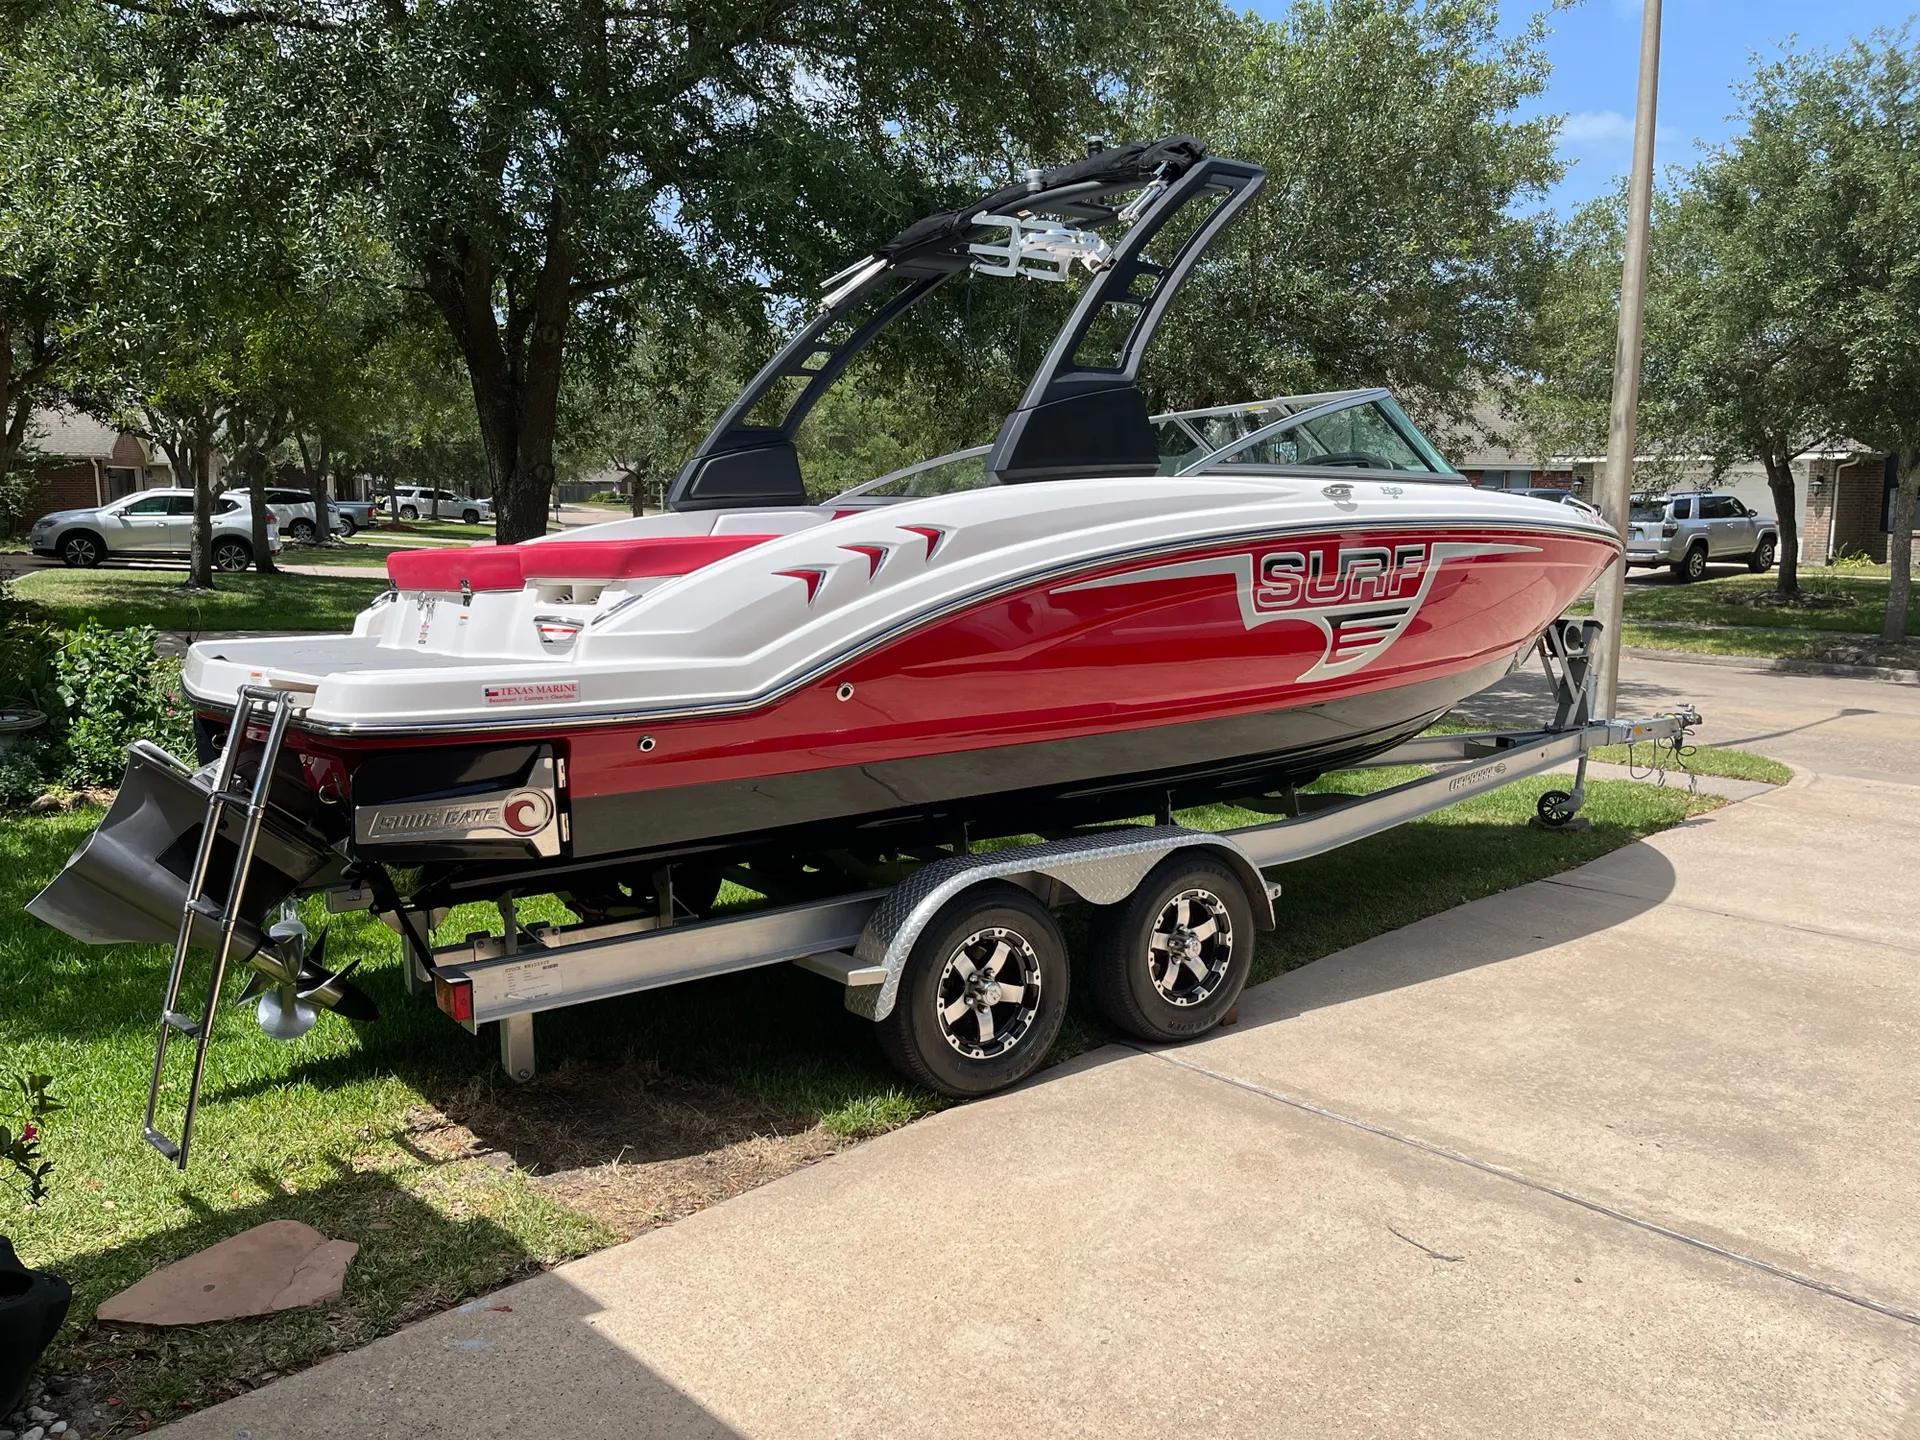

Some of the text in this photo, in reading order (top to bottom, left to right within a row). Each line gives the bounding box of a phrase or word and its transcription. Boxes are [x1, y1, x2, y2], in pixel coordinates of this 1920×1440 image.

[1257, 543, 1426, 607] SURF
[500, 683, 577, 696] TEXAS MARINE
[379, 807, 499, 830] SURF GATE
